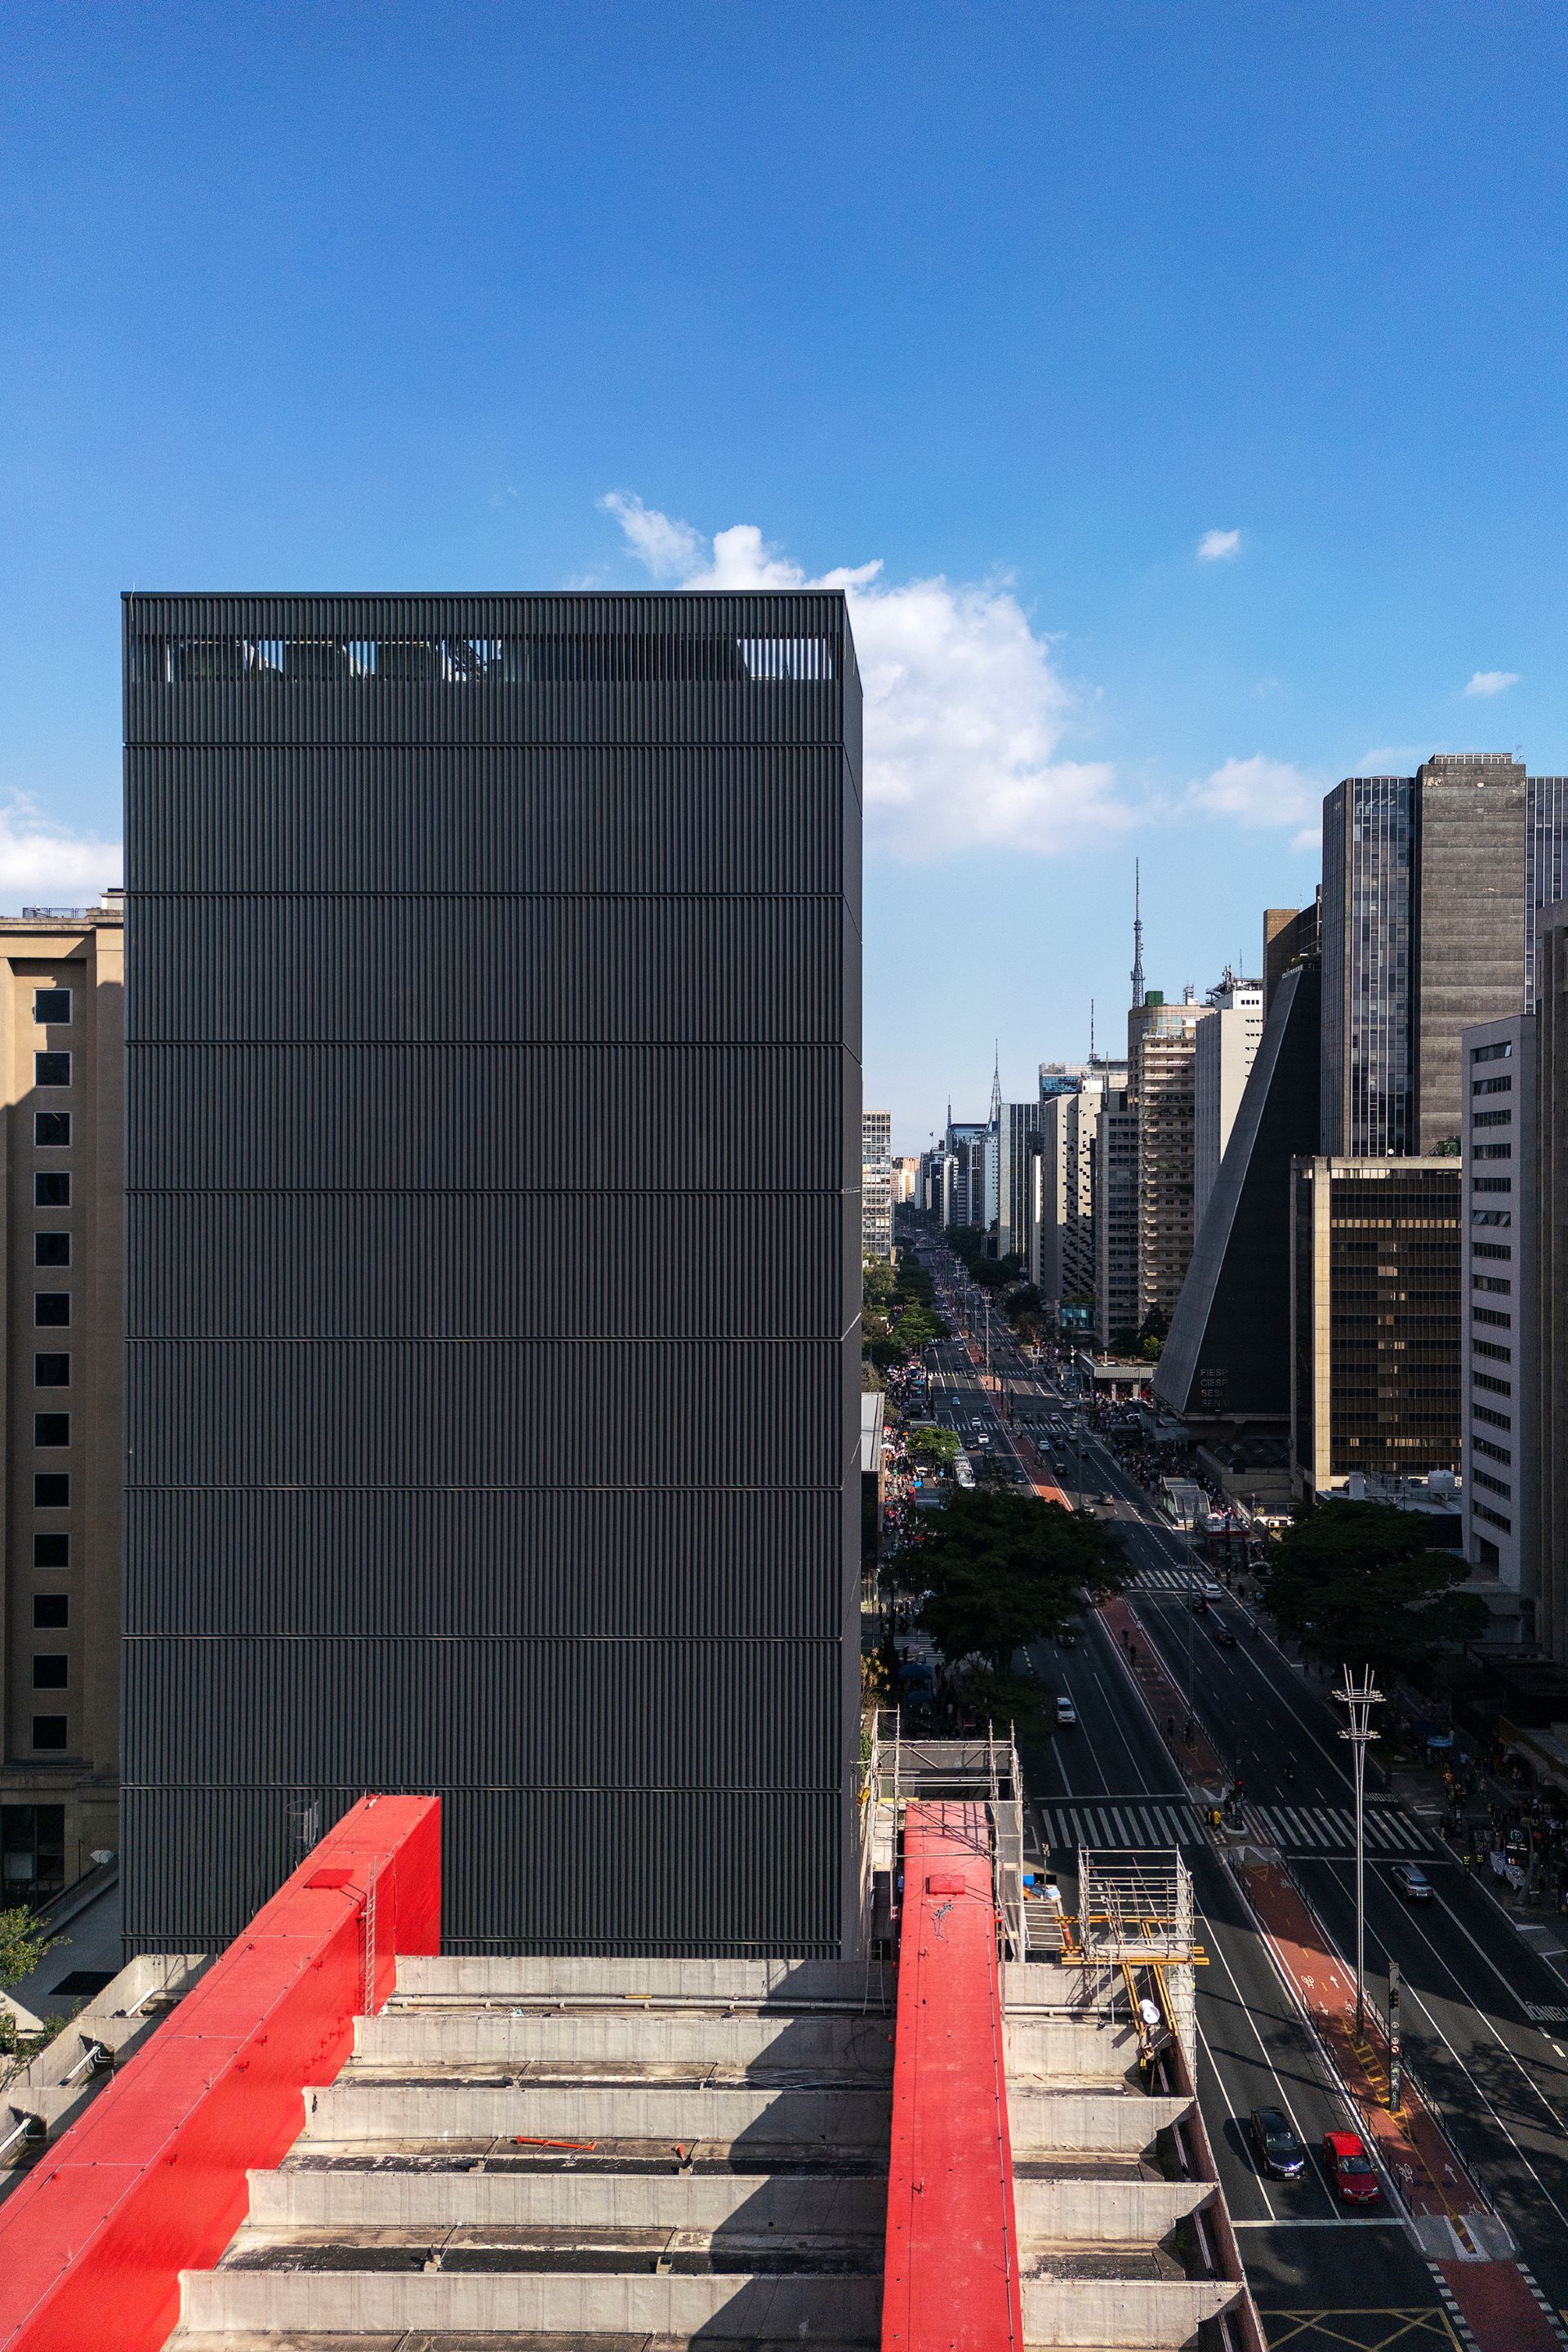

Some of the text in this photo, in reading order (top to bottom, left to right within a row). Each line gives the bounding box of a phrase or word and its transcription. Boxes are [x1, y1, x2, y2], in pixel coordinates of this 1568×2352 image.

[1200, 1368, 1228, 1376] FIESP
[1200, 1379, 1228, 1387] CIESP
[1525, 2000, 1568, 2022] ÔNIBU
